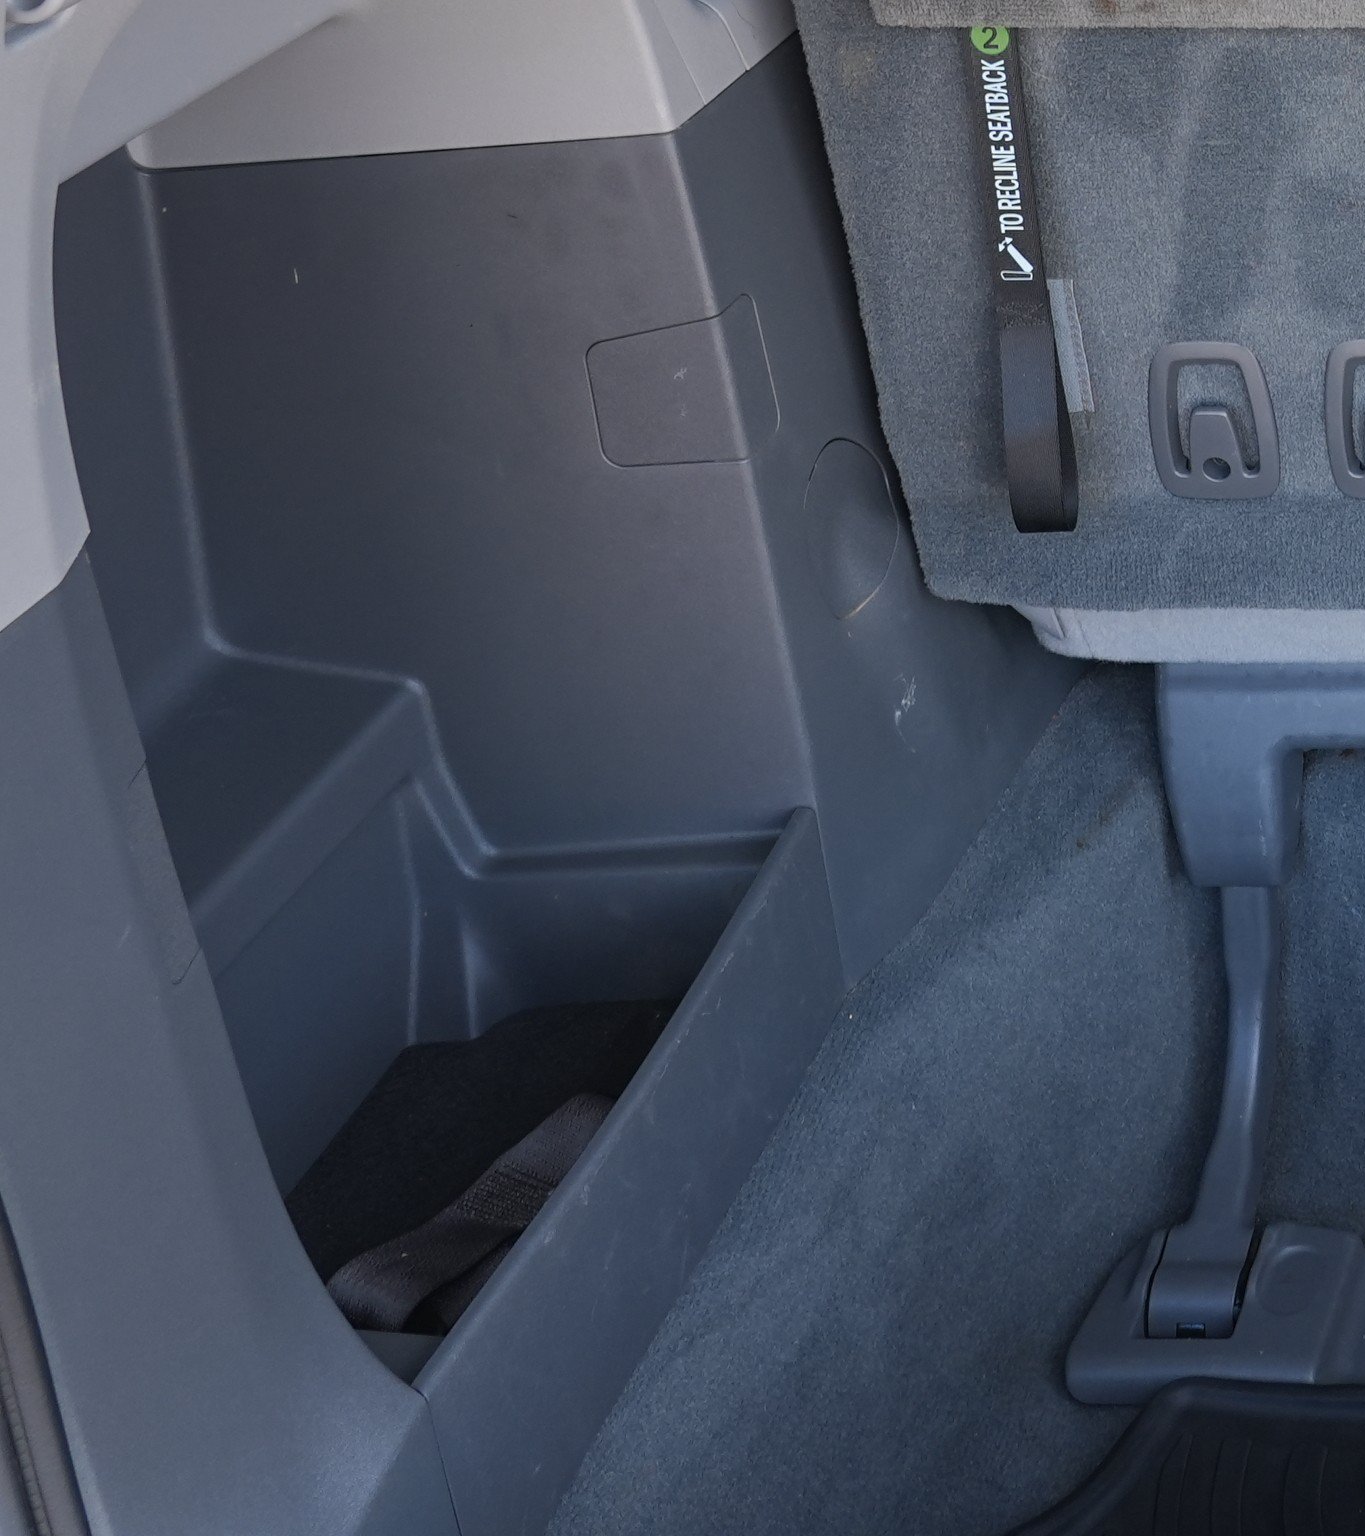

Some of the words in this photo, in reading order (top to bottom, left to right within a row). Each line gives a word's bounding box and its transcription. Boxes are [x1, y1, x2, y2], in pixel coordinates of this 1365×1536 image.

[982, 26, 1000, 50] 2
[981, 59, 1014, 142] SEATBACK
[991, 145, 1022, 210] RECLINE
[999, 213, 1024, 234] TO
